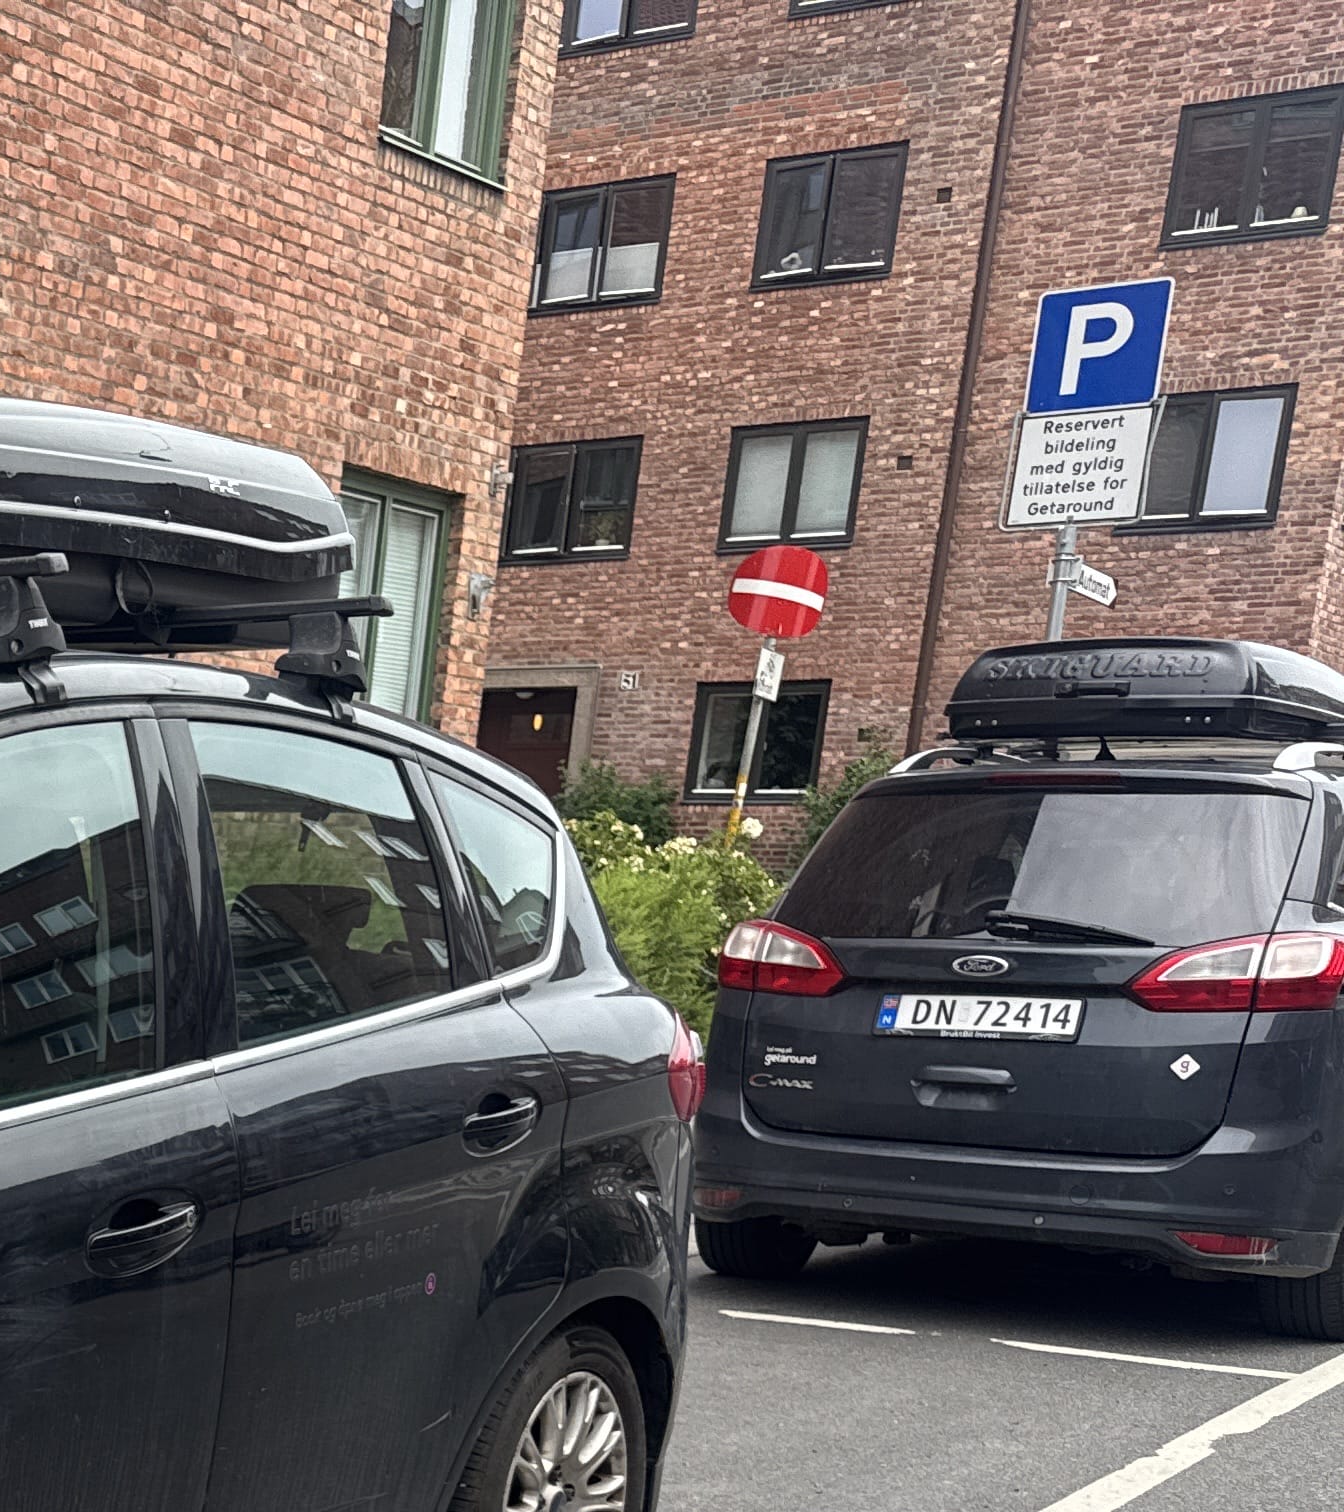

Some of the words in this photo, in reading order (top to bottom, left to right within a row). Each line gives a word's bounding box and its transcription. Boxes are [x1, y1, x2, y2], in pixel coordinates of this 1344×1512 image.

[1059, 302, 1134, 396] P
[1043, 415, 1125, 434] Reservert
[1044, 437, 1116, 454] bildeling
[1030, 460, 1065, 476] med
[1072, 456, 1124, 476] gyldig
[1023, 479, 1095, 496] tillatelse
[1103, 476, 1128, 490] for
[1027, 497, 1114, 516] Getaround
[1079, 570, 1111, 601] Automat
[986, 651, 1212, 681] SKIGUARD
[623, 672, 637, 689] 51
[963, 959, 997, 972] Ford
[882, 1015, 892, 1025] N
[911, 999, 957, 1026] DN
[973, 1000, 1072, 1030] 72414
[764, 1054, 817, 1066] getaround
